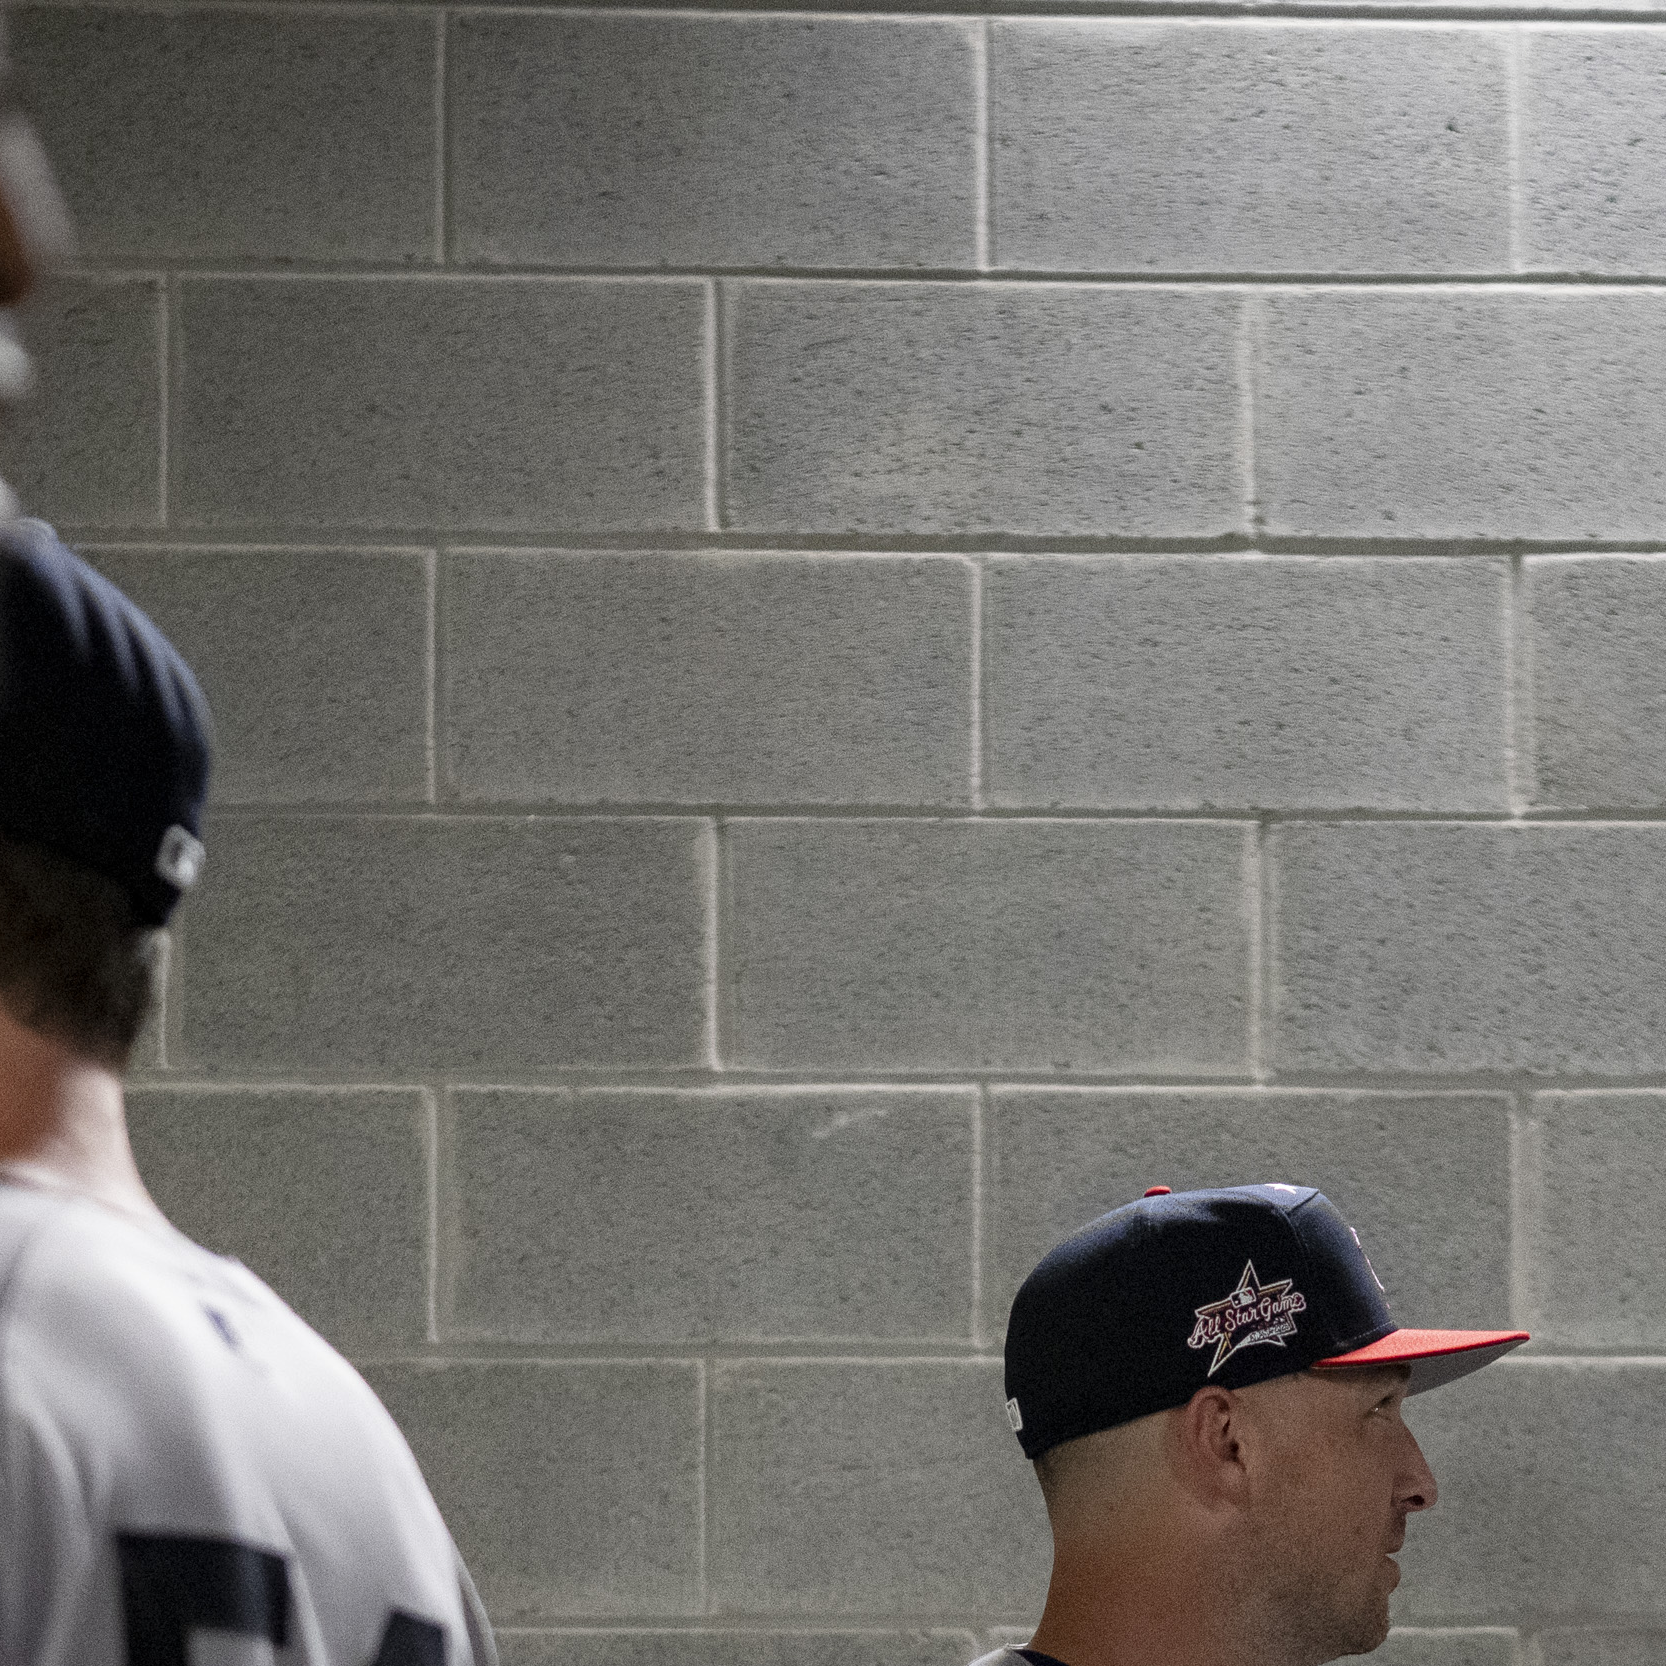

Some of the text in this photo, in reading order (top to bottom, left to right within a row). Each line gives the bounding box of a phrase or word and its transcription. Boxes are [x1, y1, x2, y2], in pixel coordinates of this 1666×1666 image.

[1190, 1313, 1222, 1345] All
[1224, 1306, 1260, 1331] Star
[1259, 1293, 1305, 1321] Game
